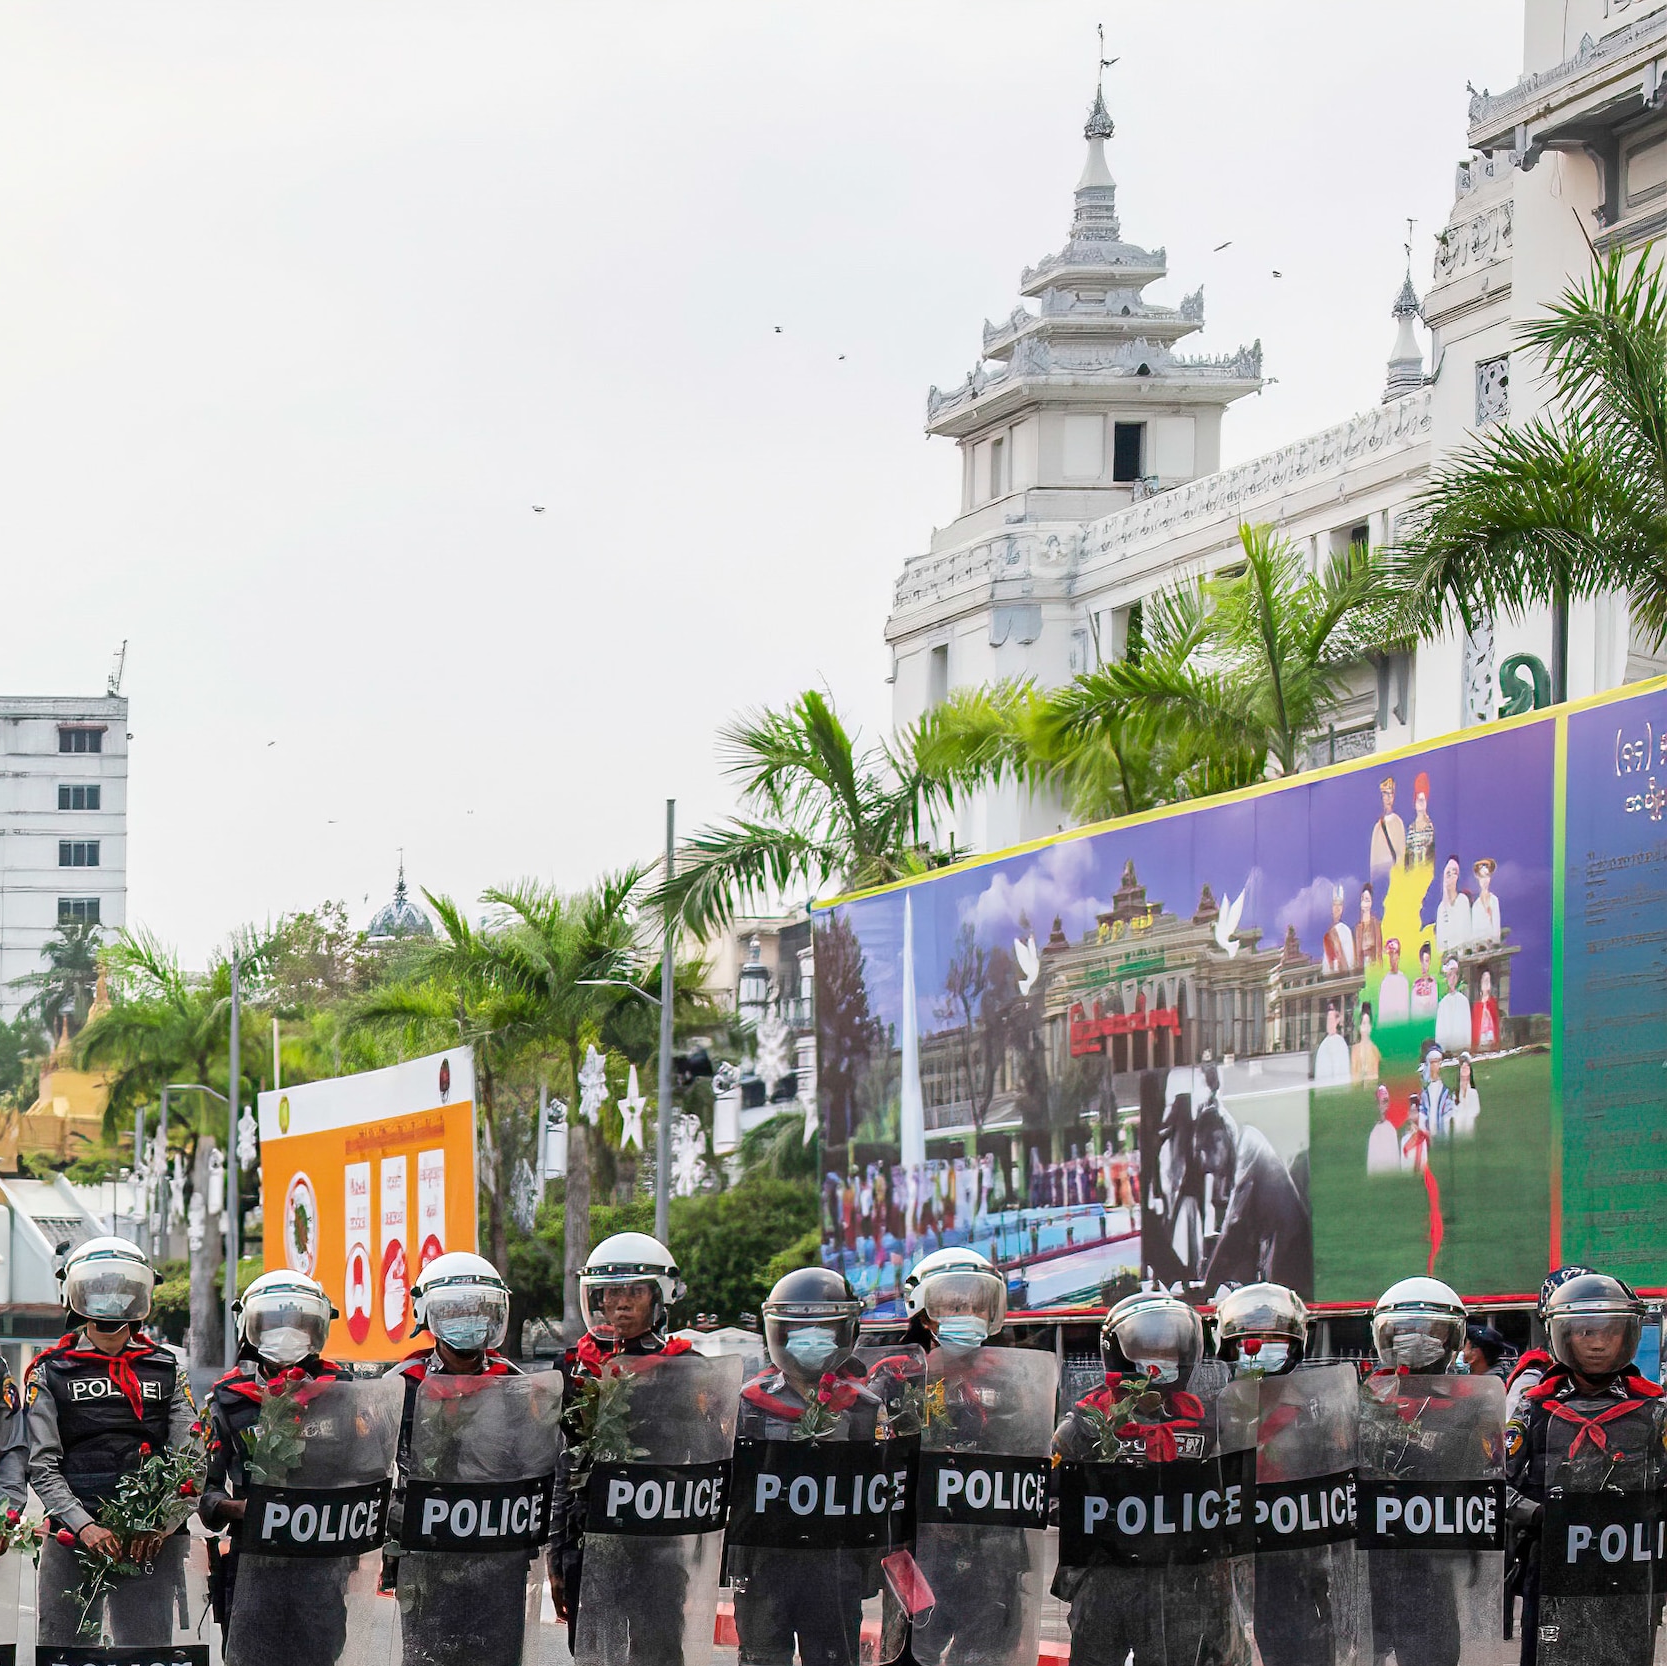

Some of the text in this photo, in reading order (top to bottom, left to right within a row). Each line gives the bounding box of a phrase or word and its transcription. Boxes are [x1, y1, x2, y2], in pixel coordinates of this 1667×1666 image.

[73, 1380, 158, 1401] POLE
[606, 1477, 724, 1519] POLICE
[755, 1470, 907, 1516] POLICE
[937, 1469, 1046, 1512] POLICE
[1084, 1484, 1242, 1534] POLICE
[261, 1498, 381, 1543] POLICE
[421, 1491, 544, 1537] POLICE
[1376, 1495, 1497, 1534] POLICE
[1567, 1521, 1665, 1563] POLI
